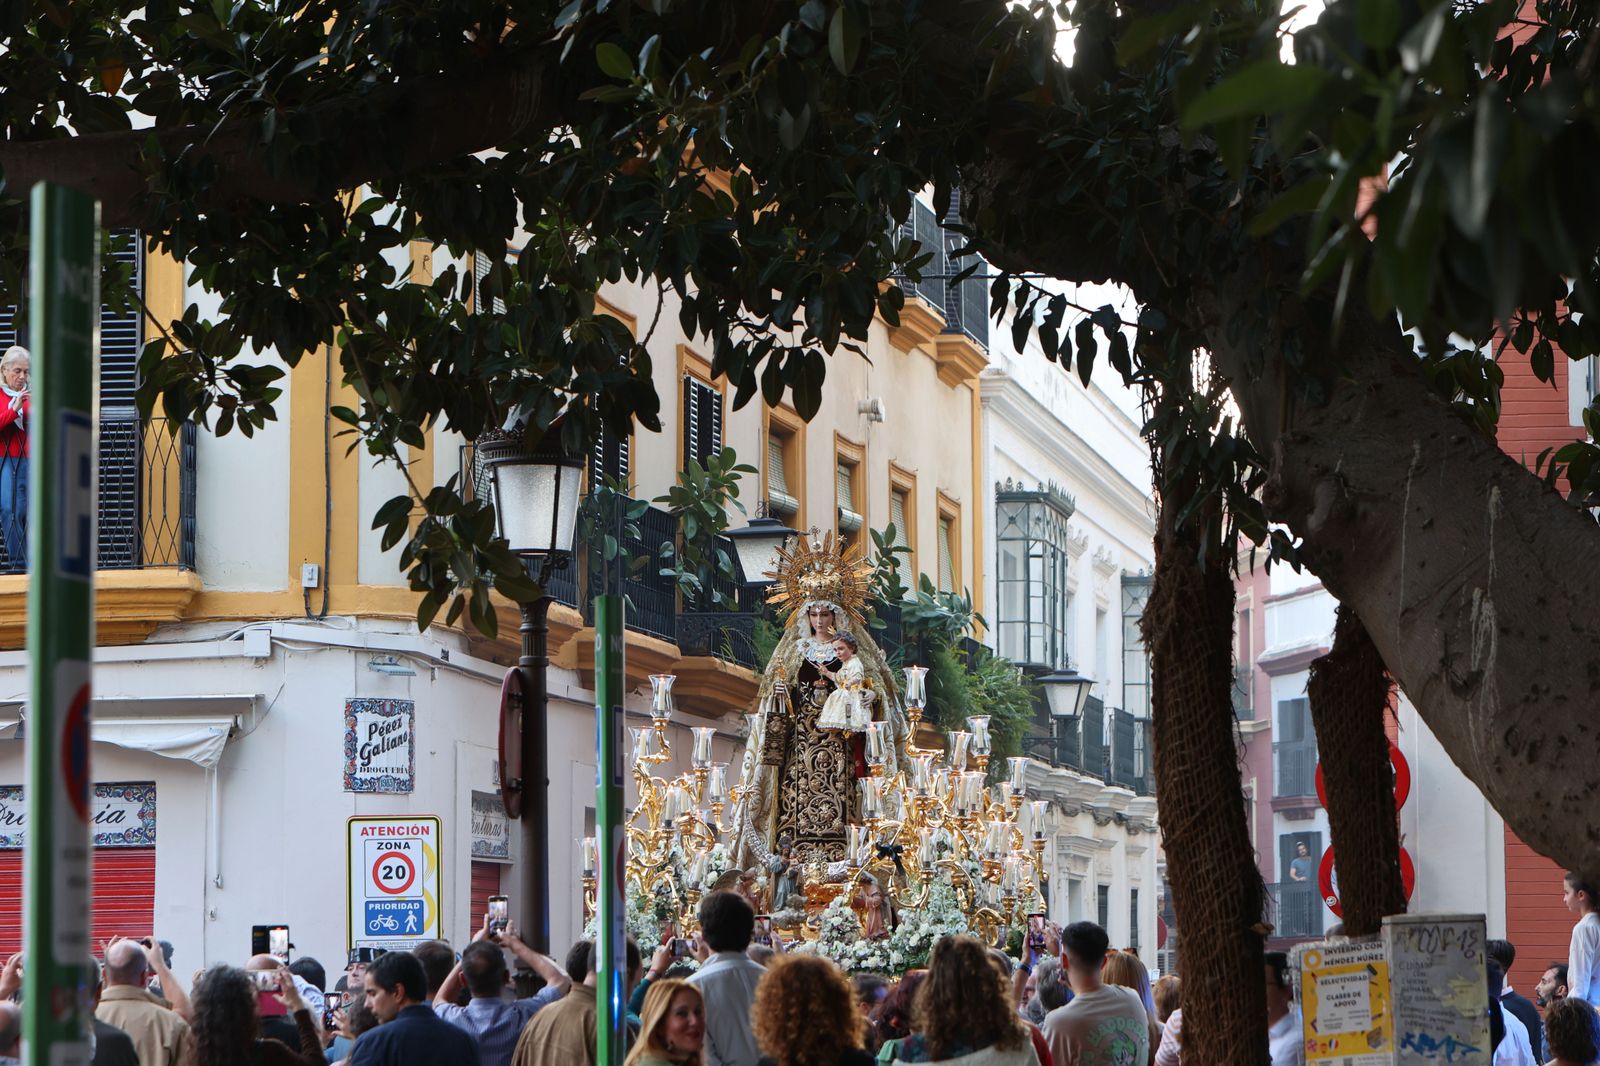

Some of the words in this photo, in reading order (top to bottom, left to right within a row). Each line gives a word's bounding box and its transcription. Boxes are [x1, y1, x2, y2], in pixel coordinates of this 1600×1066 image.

[368, 716, 403, 741] Pérez
[360, 731, 408, 767] Galiano
[360, 764, 409, 774] DROGUERÍA
[360, 824, 430, 836] ATENCIÓN
[376, 842, 411, 850] ZONA
[382, 865, 406, 880] 20
[368, 902, 420, 910] PRIORIDAD
[1364, 942, 1383, 951] CON
[1357, 952, 1384, 963] NÚÑEZ
[1326, 992, 1351, 1001] CLASES
[1334, 1000, 1357, 1008] APOYO
